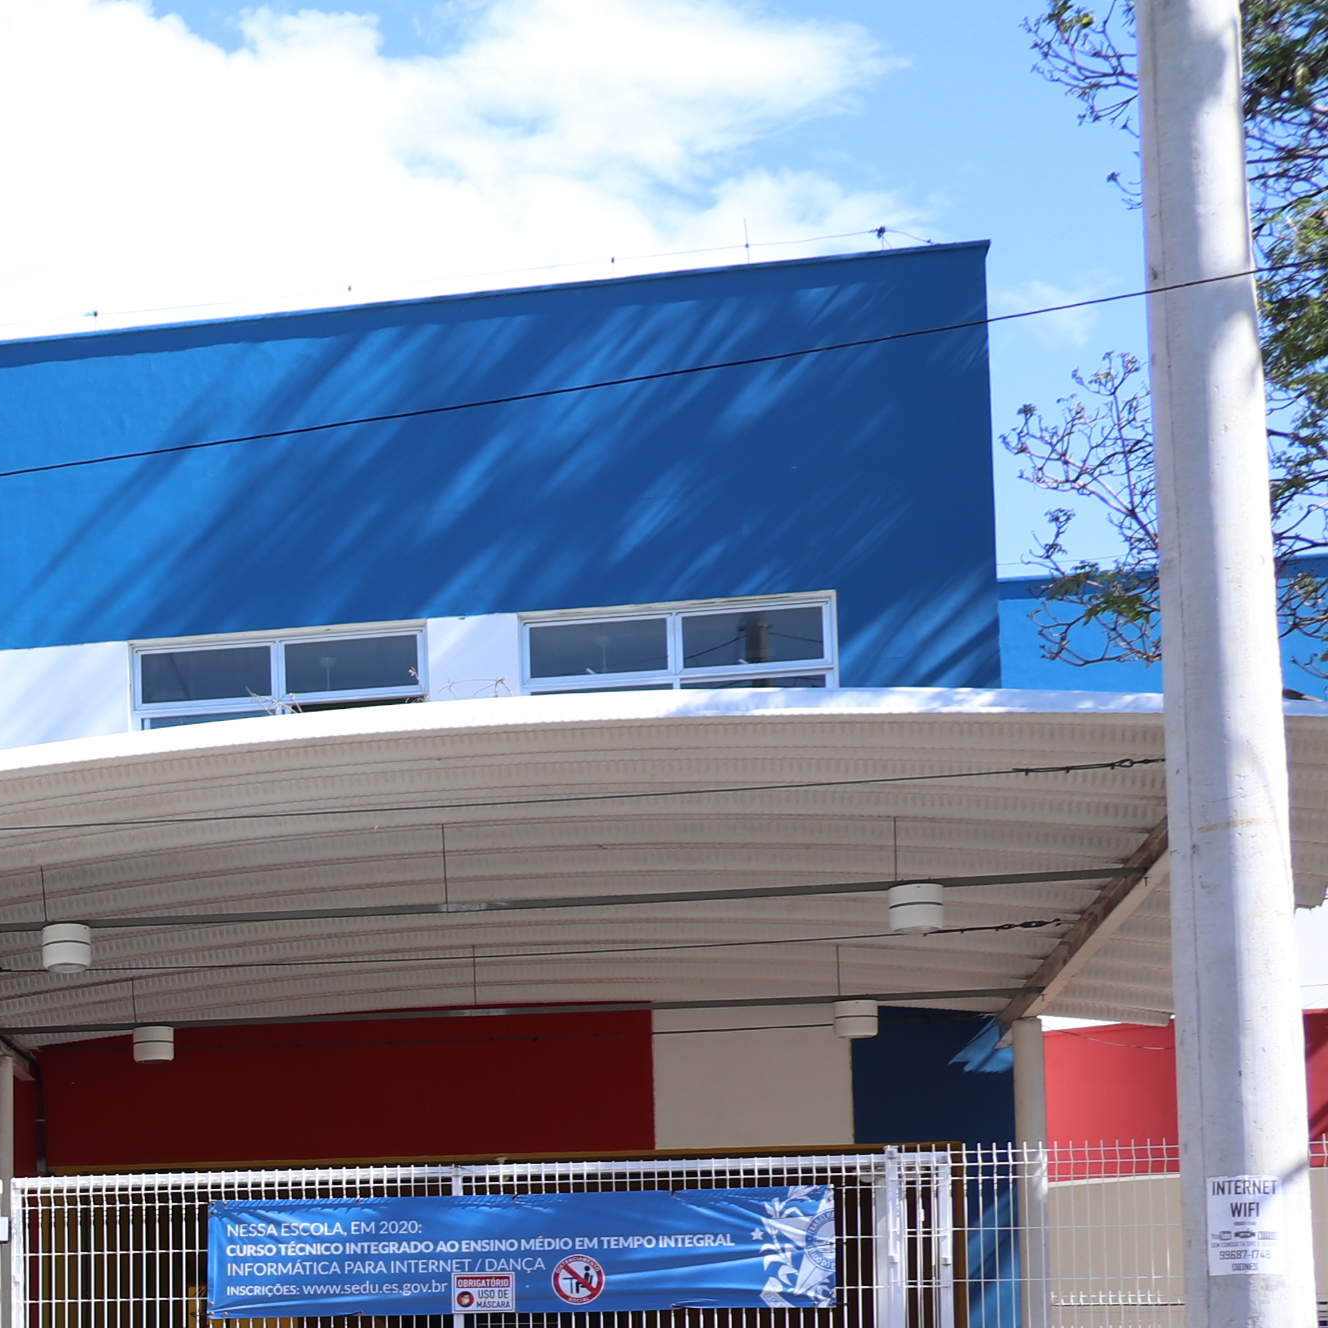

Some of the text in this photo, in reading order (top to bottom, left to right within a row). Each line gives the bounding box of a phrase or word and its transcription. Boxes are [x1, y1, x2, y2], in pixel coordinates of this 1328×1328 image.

[1212, 1179, 1278, 1196] INTERNET
[1230, 1201, 1260, 1218] WIFI
[226, 1220, 423, 1238] NESSA ESCOLA, EM 2020:
[226, 1232, 735, 1257] CURSO TÉCNICO INTEGRADO AO ENSINO MÉDIO EM TEMPO INTEGRAL
[1219, 1249, 1271, 1261] 99687-1748
[226, 1257, 546, 1277] INFORMÁTICA PARA INTERNET / DANÇA
[226, 1279, 449, 1298] INSCRIÇÕES: www.sedu.es.gov.br
[457, 1277, 510, 1288] OBRIGATÓRIO
[477, 1289, 509, 1299] USO DE
